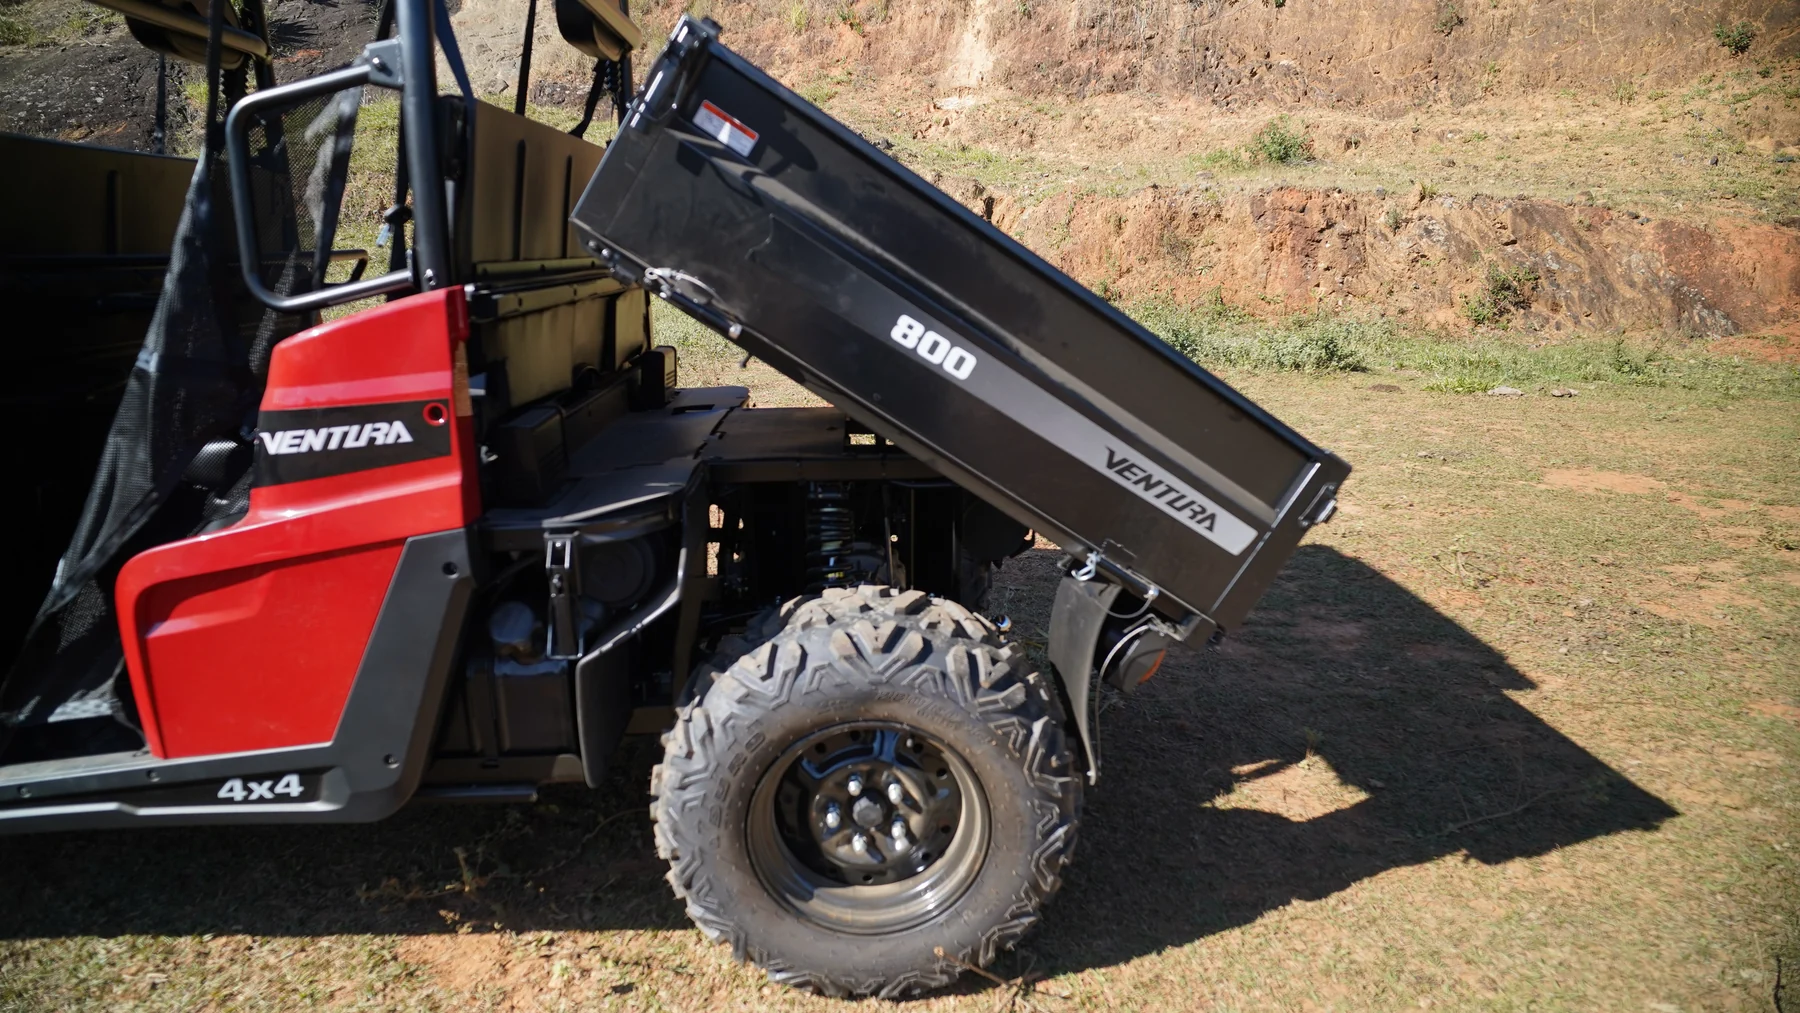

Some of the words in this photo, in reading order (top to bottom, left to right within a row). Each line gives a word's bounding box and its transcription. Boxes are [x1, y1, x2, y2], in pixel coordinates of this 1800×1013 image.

[890, 314, 978, 381] 800
[259, 420, 414, 455] VENTURA
[1105, 444, 1218, 533] VENTURA
[217, 773, 305, 802] 4x4
